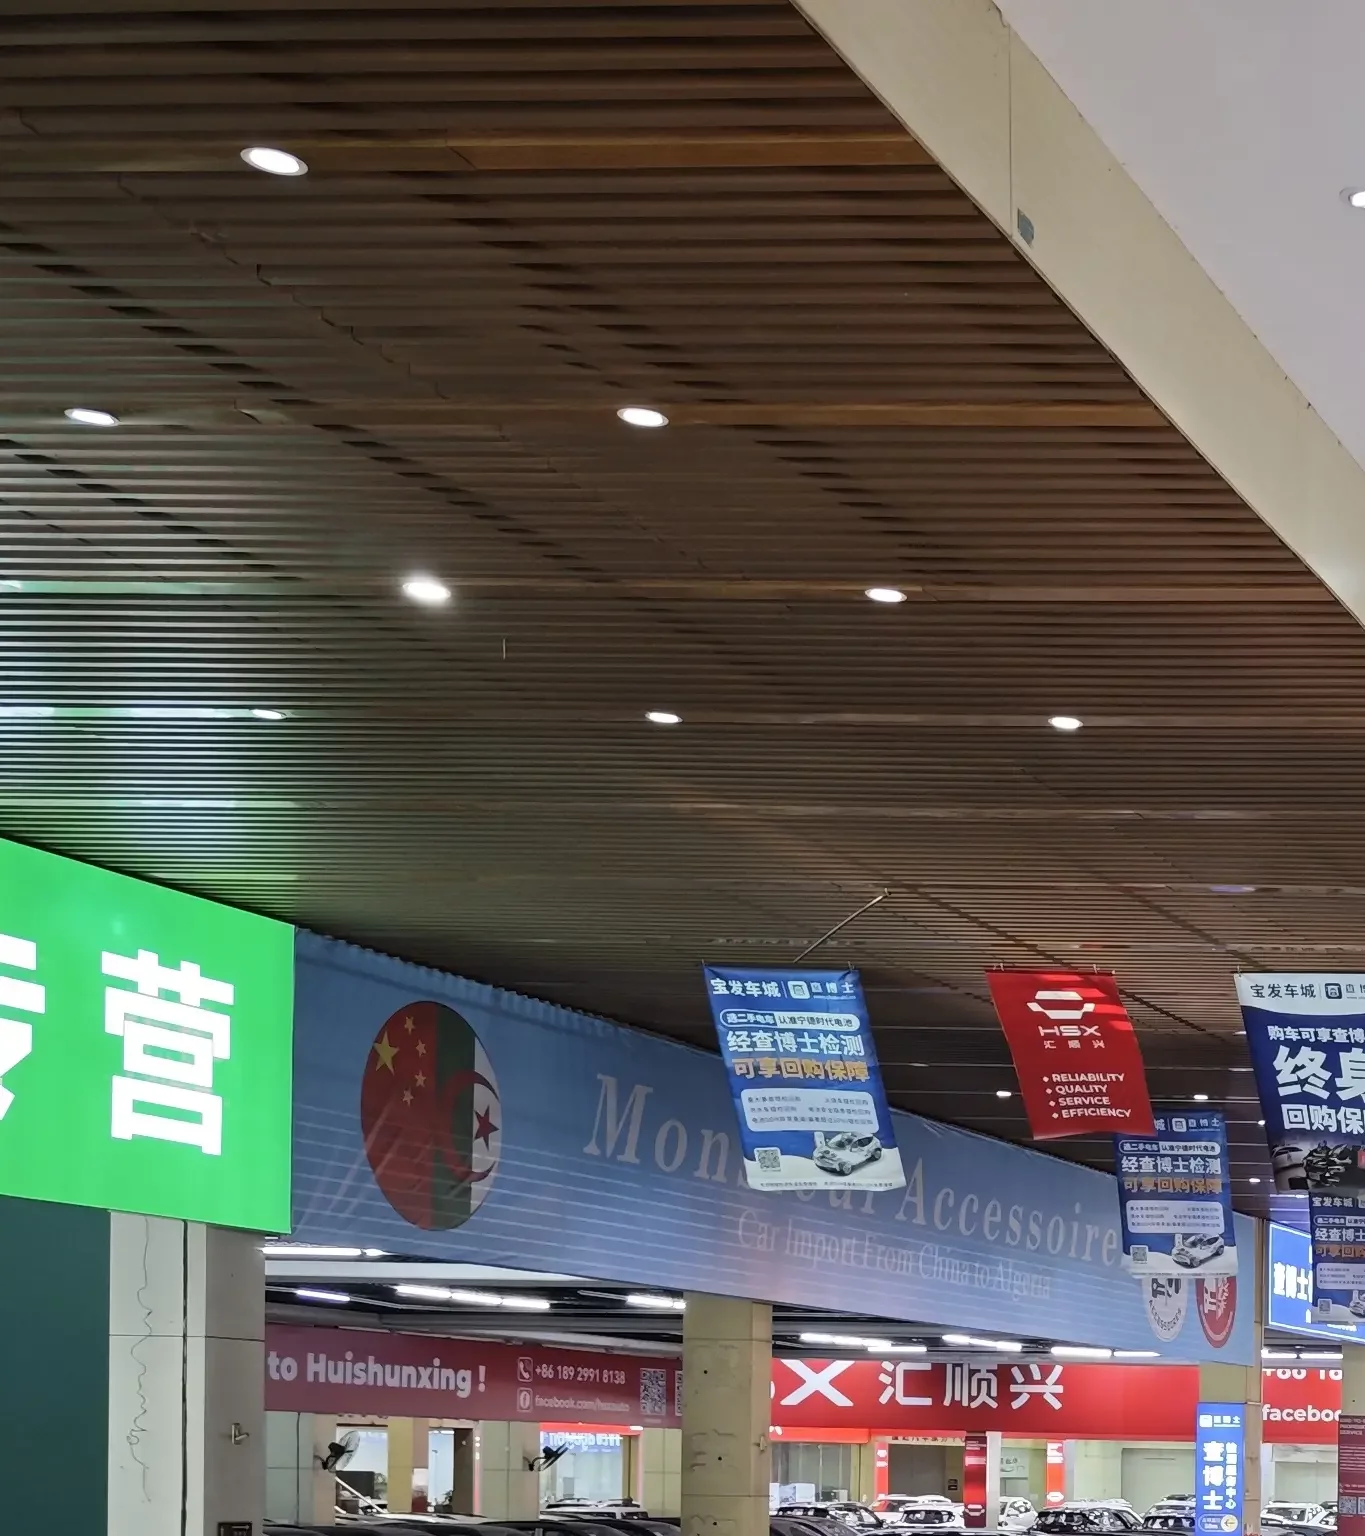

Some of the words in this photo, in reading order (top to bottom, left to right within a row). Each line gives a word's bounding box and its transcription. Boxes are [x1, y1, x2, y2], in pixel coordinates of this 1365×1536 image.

[710, 977, 782, 998] 宝发车城
[1250, 983, 1317, 999] 宝发车城
[779, 1015, 853, 1028] 认准宁德时代电池
[1038, 1025, 1102, 1037] HSX
[726, 1030, 865, 1057] 经查博士检测
[731, 1057, 871, 1083] 可享回购保障
[1052, 1072, 1125, 1083] RELIABILITY
[1055, 1084, 1108, 1095] QUALITY
[1058, 1096, 1111, 1107] SERVICE
[1062, 1108, 1132, 1119] EFFICIENCY
[1121, 1156, 1222, 1175] 经查博士检测
[1123, 1177, 1223, 1195] 可享回购保障
[738, 1209, 781, 1252] Car
[785, 1217, 856, 1271] Import
[862, 1233, 914, 1275] From
[918, 1243, 969, 1286] China
[268, 1351, 298, 1382] to
[306, 1351, 473, 1398] Huishunxing
[535, 1363, 555, 1379] +86
[556, 1365, 575, 1380] 189
[577, 1366, 600, 1383] 2991
[602, 1369, 626, 1385] 8138
[770, 1358, 856, 1407] X
[878, 1360, 1064, 1410] 汇顺兴
